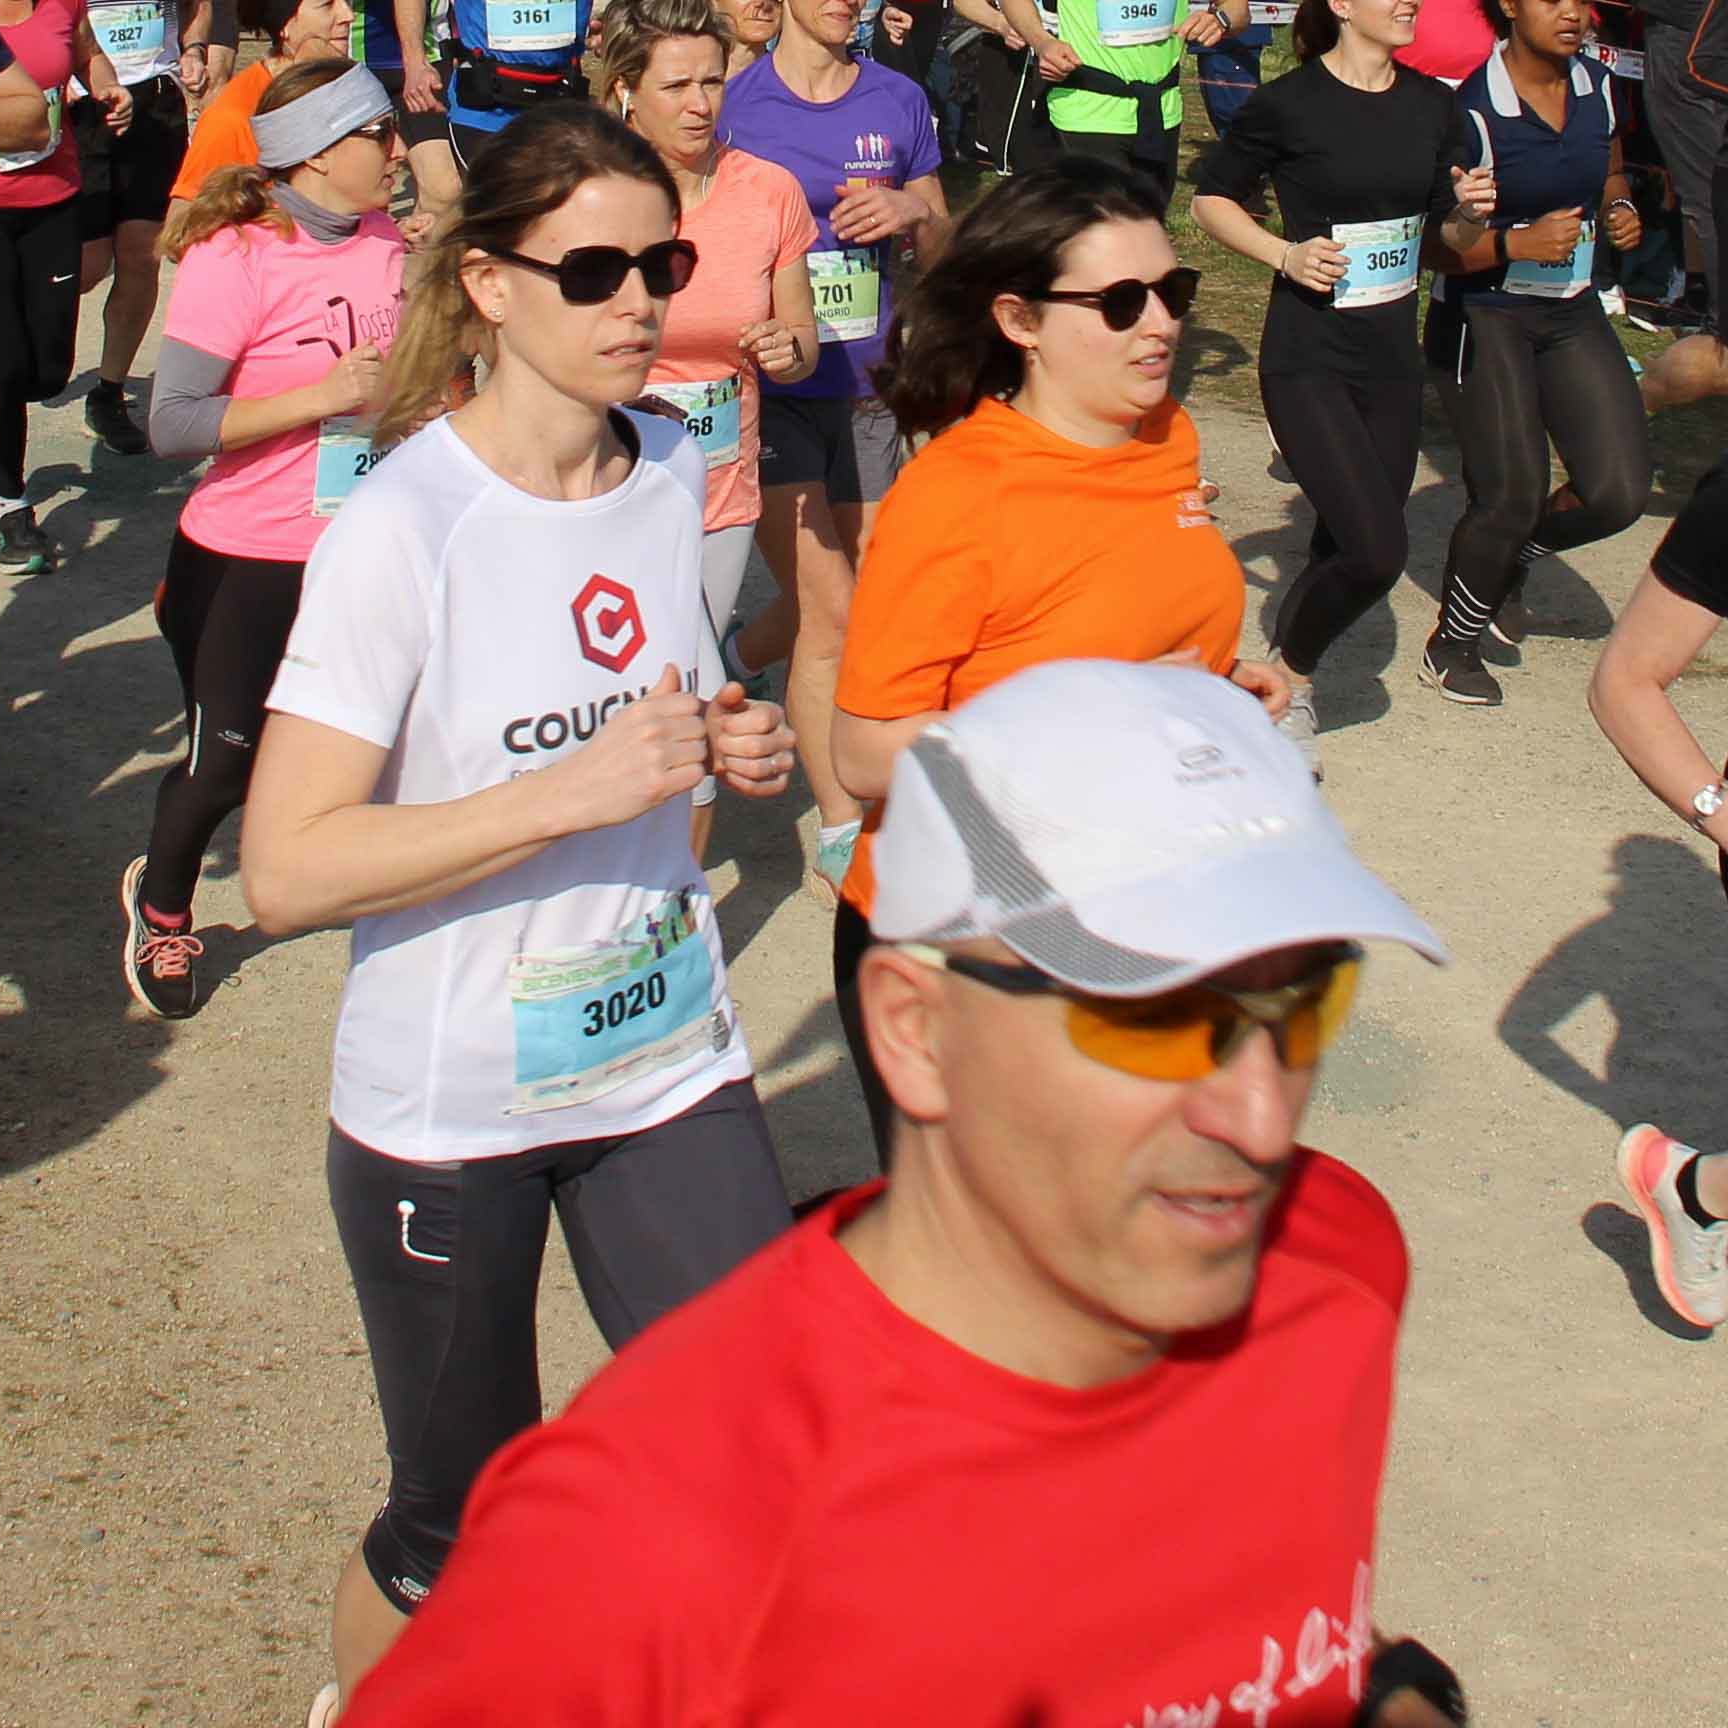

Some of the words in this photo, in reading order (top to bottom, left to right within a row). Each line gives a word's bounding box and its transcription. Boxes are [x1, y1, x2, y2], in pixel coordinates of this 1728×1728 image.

[512, 9, 552, 24] 3161
[1121, 3, 1158, 19] 3946
[108, 27, 143, 43] 2827
[1367, 248, 1409, 271] 3052
[818, 283, 854, 306] 701
[686, 415, 713, 437] 68
[582, 971, 667, 1038] 3020
